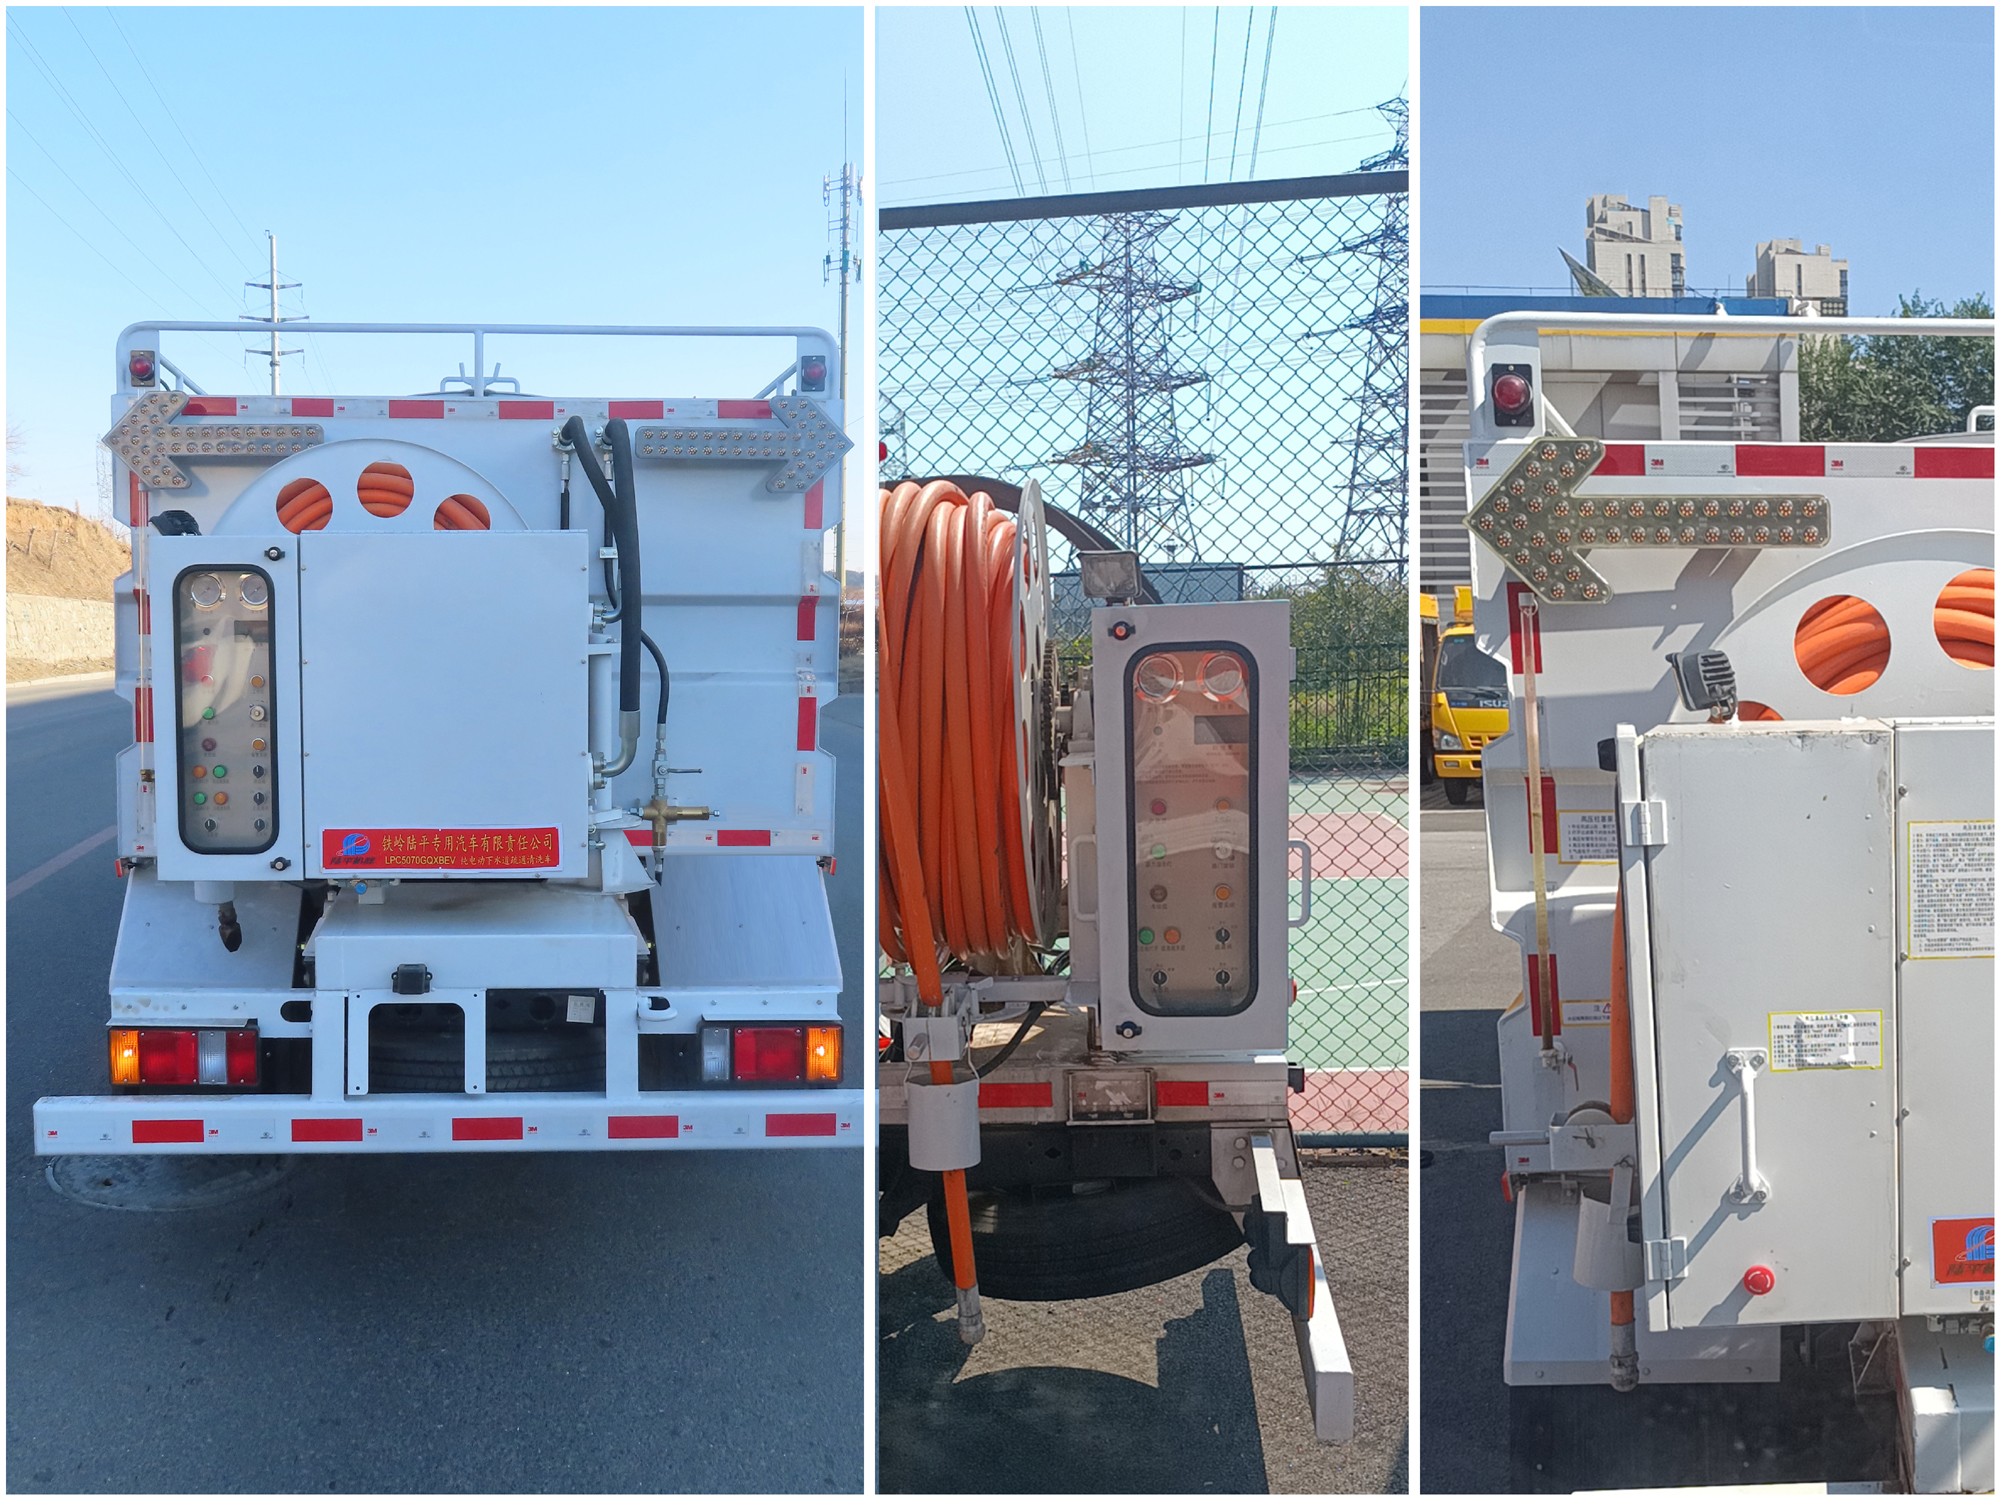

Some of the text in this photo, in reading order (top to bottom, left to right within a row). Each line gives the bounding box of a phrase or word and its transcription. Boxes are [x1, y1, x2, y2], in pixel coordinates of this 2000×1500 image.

[1480, 700, 1508, 708] ISUZ
[382, 834, 552, 852] 铁岭陆平专用汽车有限责任公司
[385, 854, 552, 865] LPC5070GQXBEV 纯电动下水道疏通清洗车
